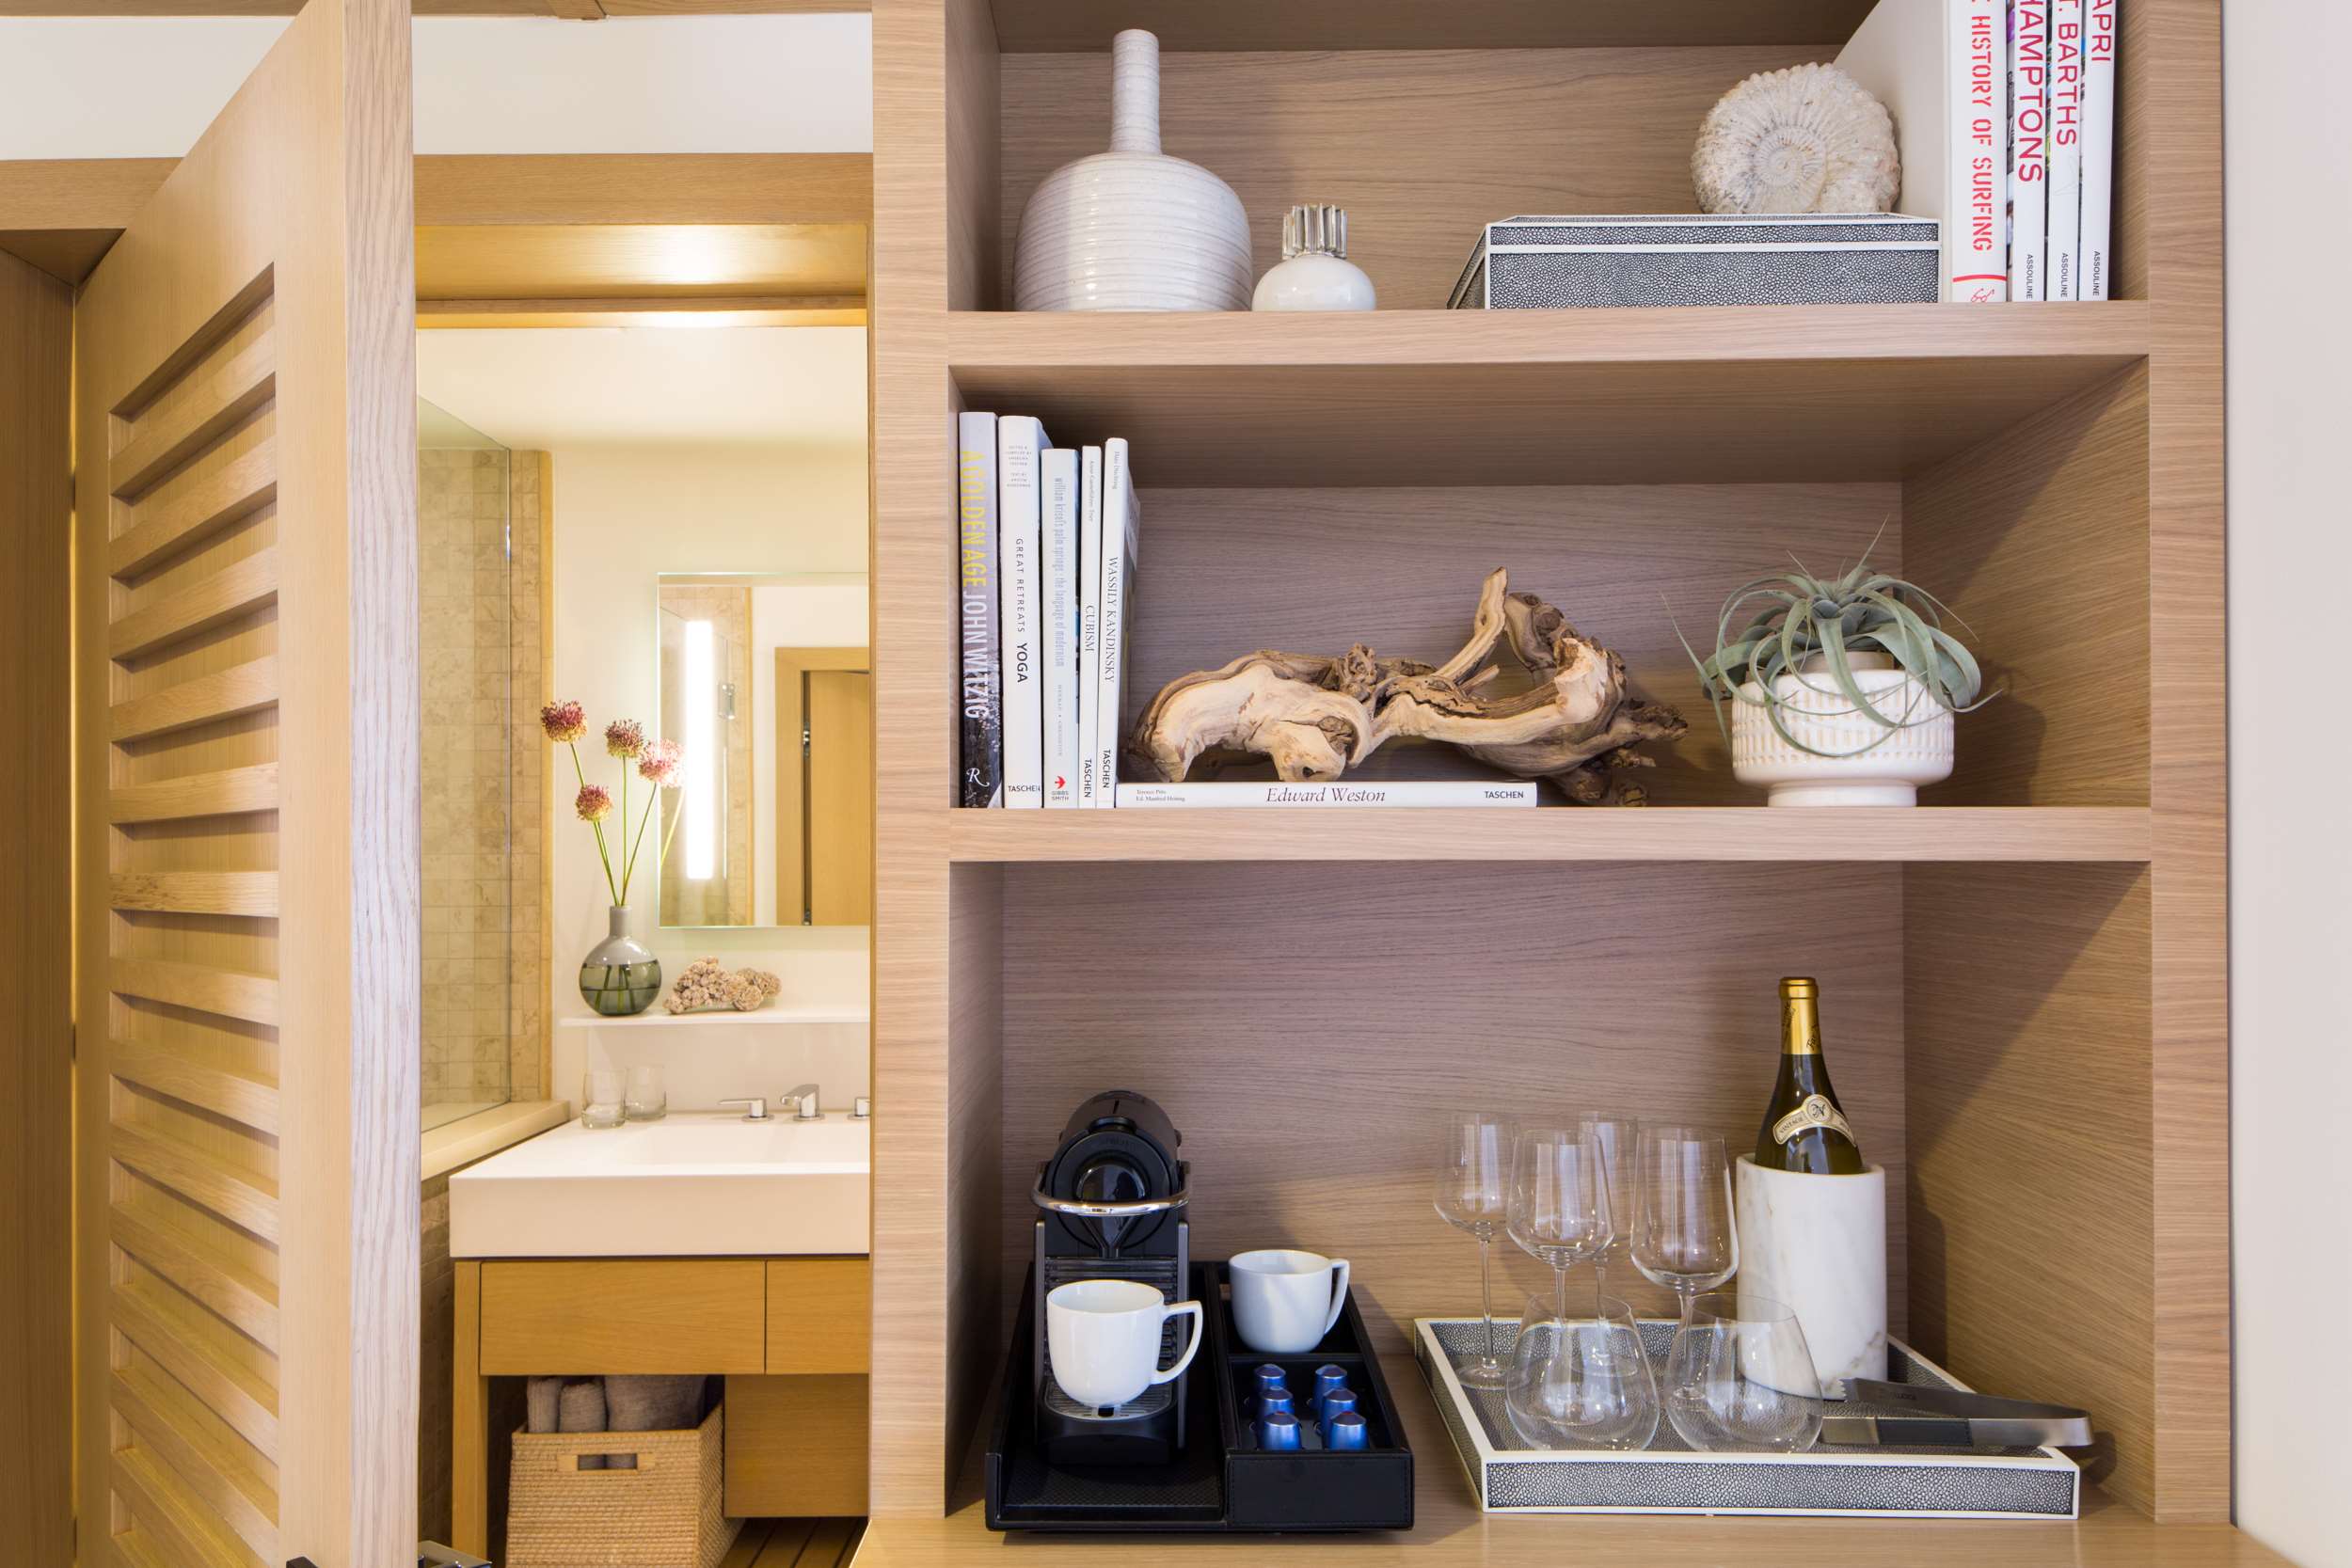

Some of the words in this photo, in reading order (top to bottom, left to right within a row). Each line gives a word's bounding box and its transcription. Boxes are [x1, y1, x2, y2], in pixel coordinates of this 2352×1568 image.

[1972, 16, 1992, 106] HISTORY
[2057, 23, 2078, 146] BARTHS
[1972, 119, 1992, 146] OF
[1972, 157, 1993, 251] SURFING
[2060, 252, 2069, 298] ASSOULINE
[2092, 250, 2101, 296] ASSOULINE
[961, 467, 987, 545] GOLDEN
[962, 548, 987, 588] AGE
[1015, 538, 1025, 573] GREAT
[1016, 578, 1025, 633] RETREATS
[1106, 556, 1119, 609] WASSILY
[963, 591, 988, 643] JOHN
[1085, 605, 1095, 652] CUBISM
[1016, 642, 1028, 683] YOGA
[1104, 610, 1117, 684] KANDINSKY
[963, 646, 989, 719] WITZIG
[1008, 784, 1041, 793] TASCHEN
[1084, 758, 1092, 798] TASCHEN
[1103, 749, 1111, 788] TASCHEN
[1266, 786, 1327, 802] Edward
[1331, 787, 1386, 802] Weston
[1484, 790, 1524, 799] TASCHEN
